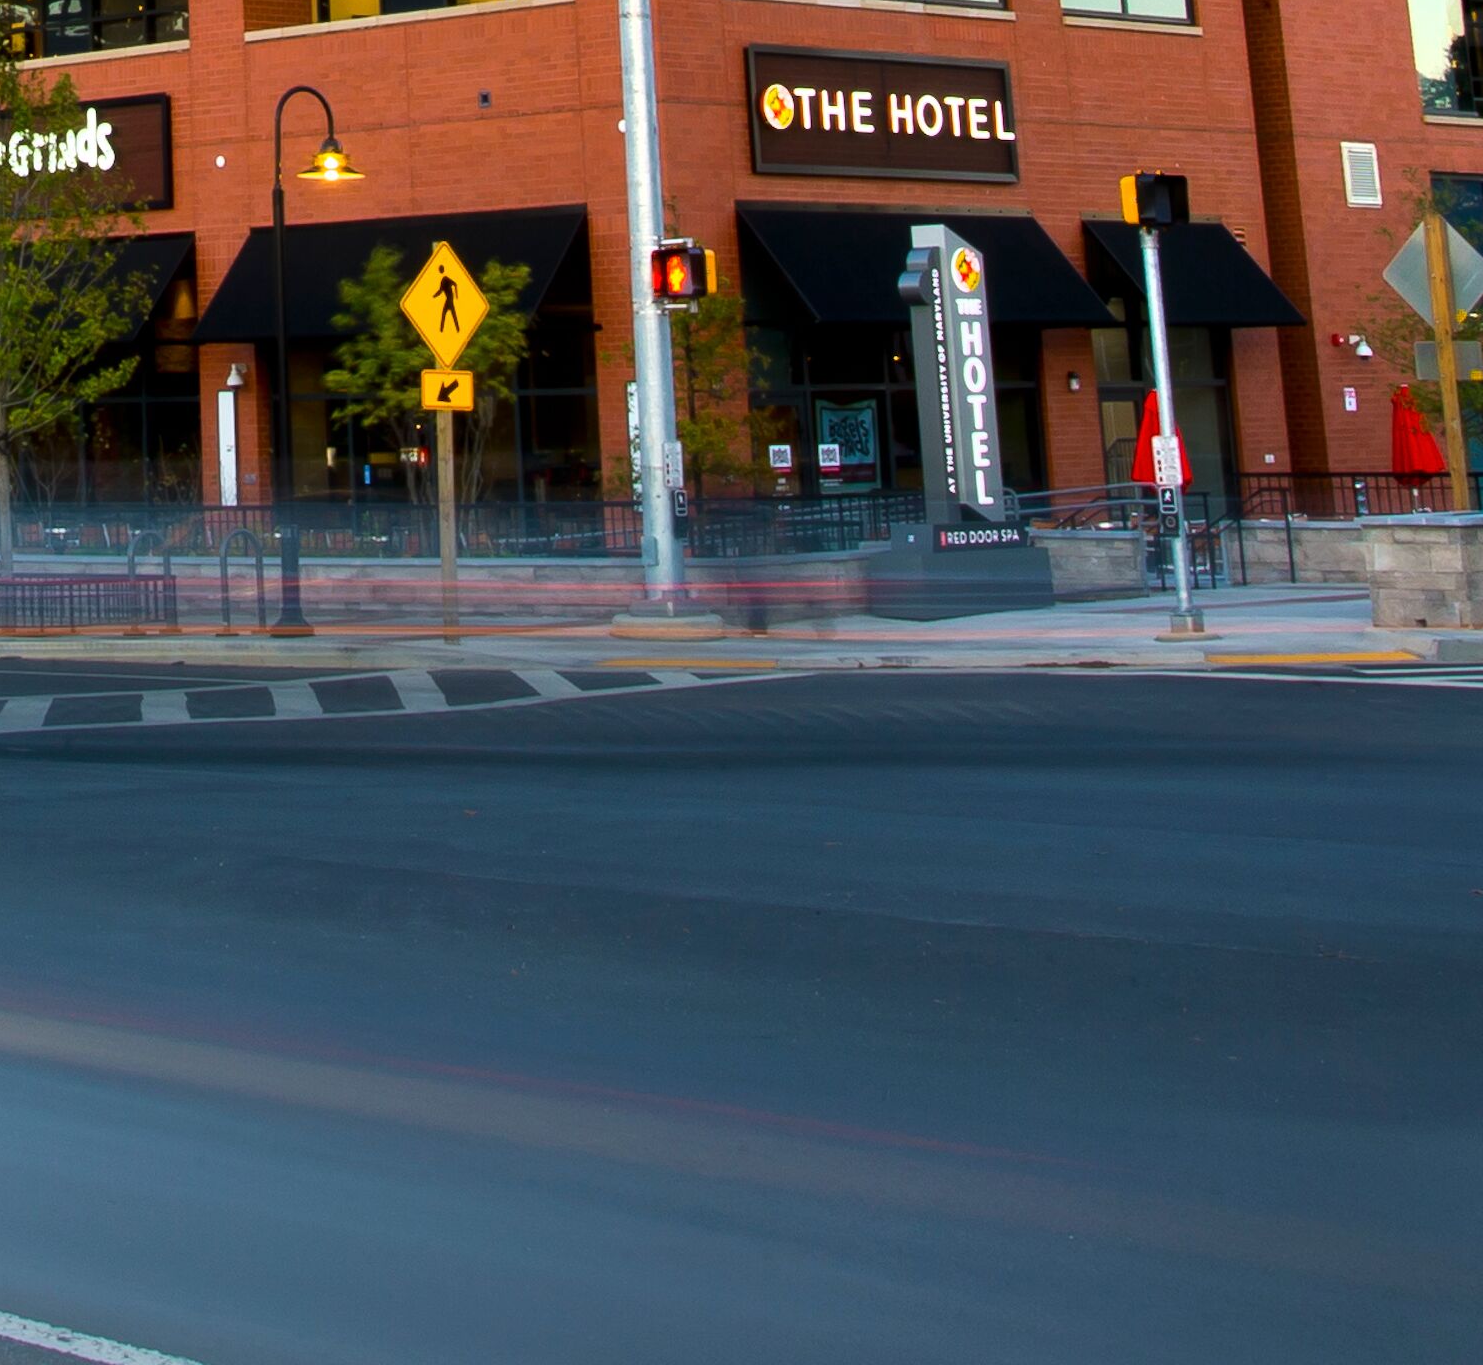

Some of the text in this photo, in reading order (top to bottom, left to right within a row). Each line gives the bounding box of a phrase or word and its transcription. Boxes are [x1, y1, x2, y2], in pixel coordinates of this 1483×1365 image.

[793, 87, 1016, 141] THE HOTEL
[955, 298, 983, 315] THE
[931, 268, 956, 494] AT THE UNIVERSITY OF MARYLAND
[960, 321, 994, 505] HOTEL
[947, 528, 1020, 545] RED DOOR SPA
